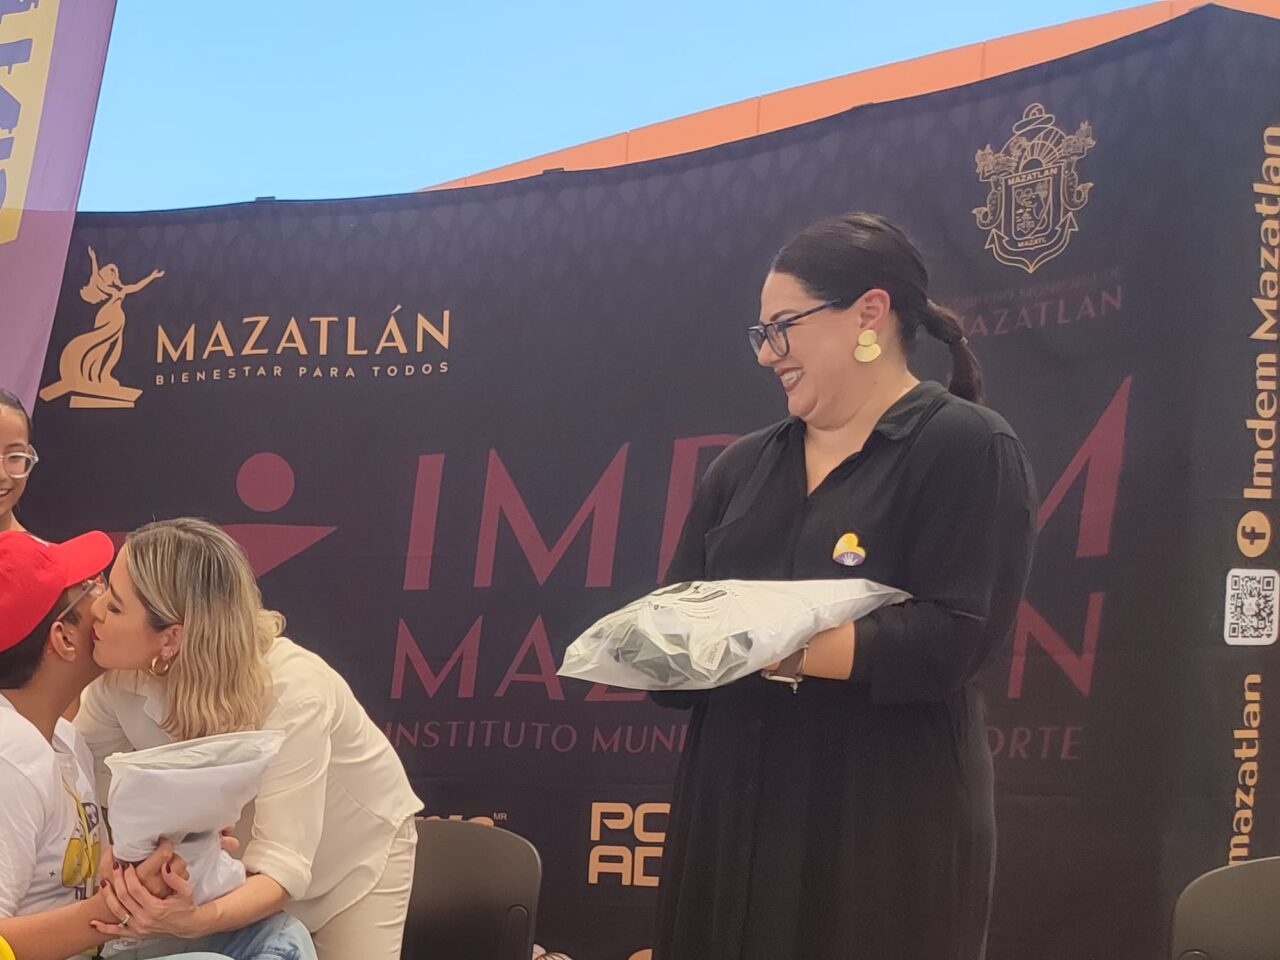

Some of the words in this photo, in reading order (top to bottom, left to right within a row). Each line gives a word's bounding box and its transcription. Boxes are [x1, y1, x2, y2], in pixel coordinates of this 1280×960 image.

[156, 304, 450, 364] MAZATLÁN
[156, 366, 283, 386] BIENESTAR
[298, 366, 356, 379] PARA
[372, 361, 450, 377] TODOS
[1243, 353, 1277, 499] Imdem
